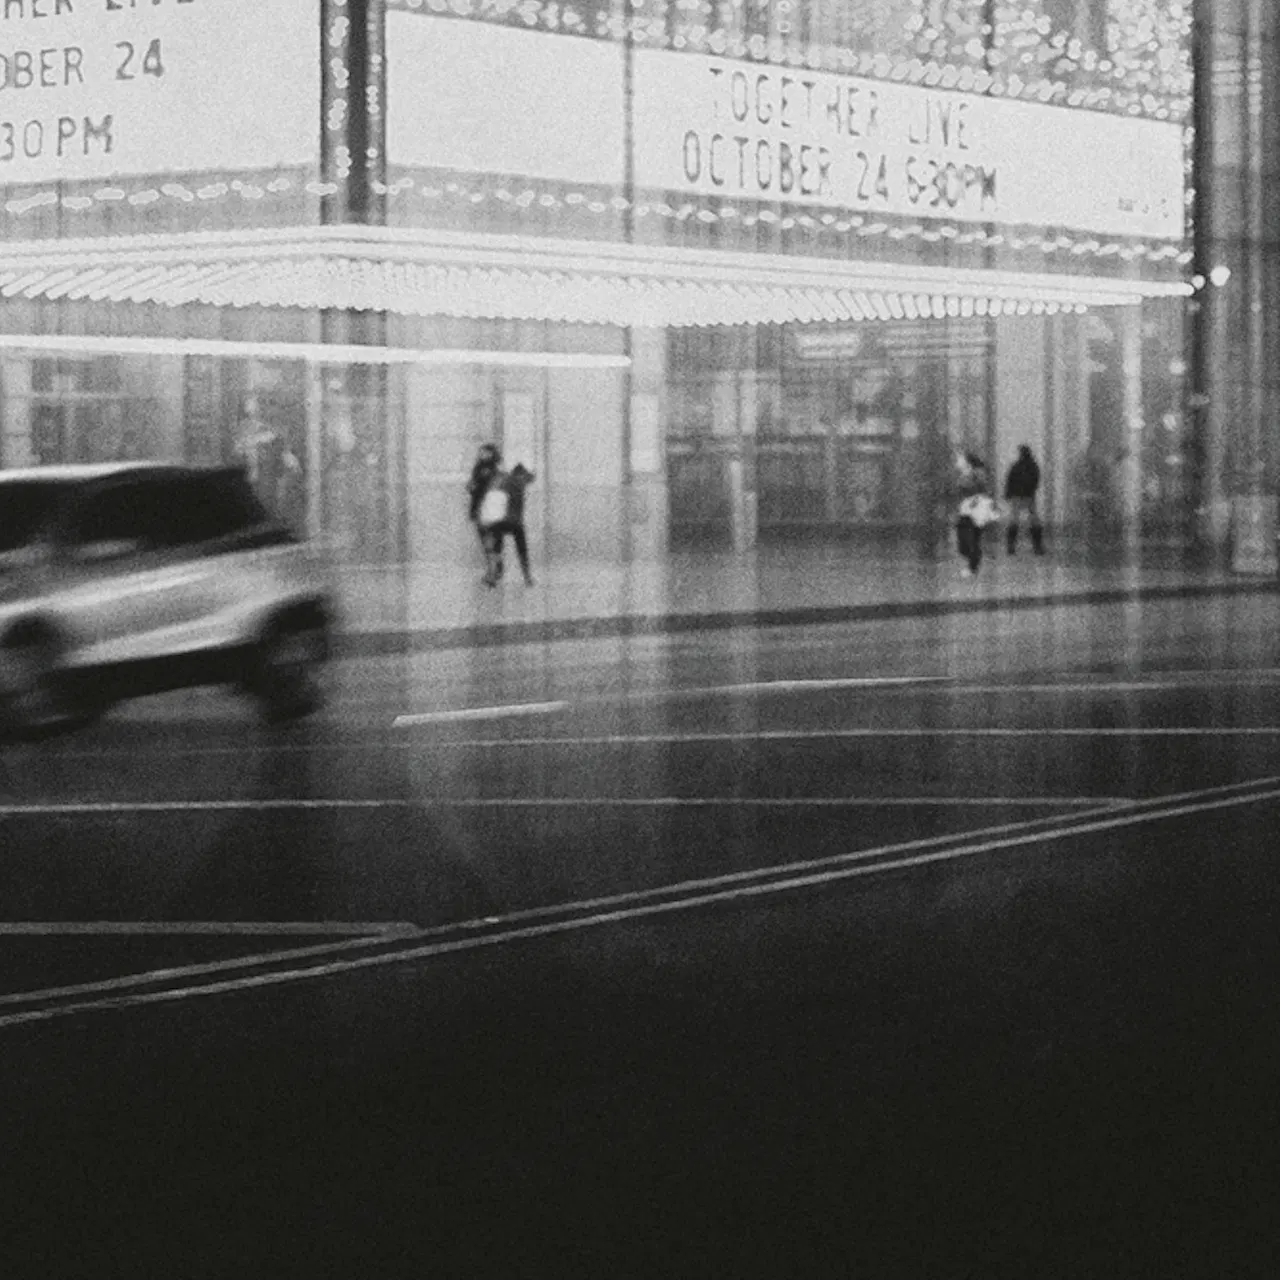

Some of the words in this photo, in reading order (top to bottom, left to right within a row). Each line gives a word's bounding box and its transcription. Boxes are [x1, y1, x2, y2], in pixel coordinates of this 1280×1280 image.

[114, 37, 165, 81] 24
[708, 66, 880, 138] TOGETHER
[908, 95, 969, 150] LIVE
[682, 129, 833, 197] OCTOBER
[855, 150, 890, 202] 24
